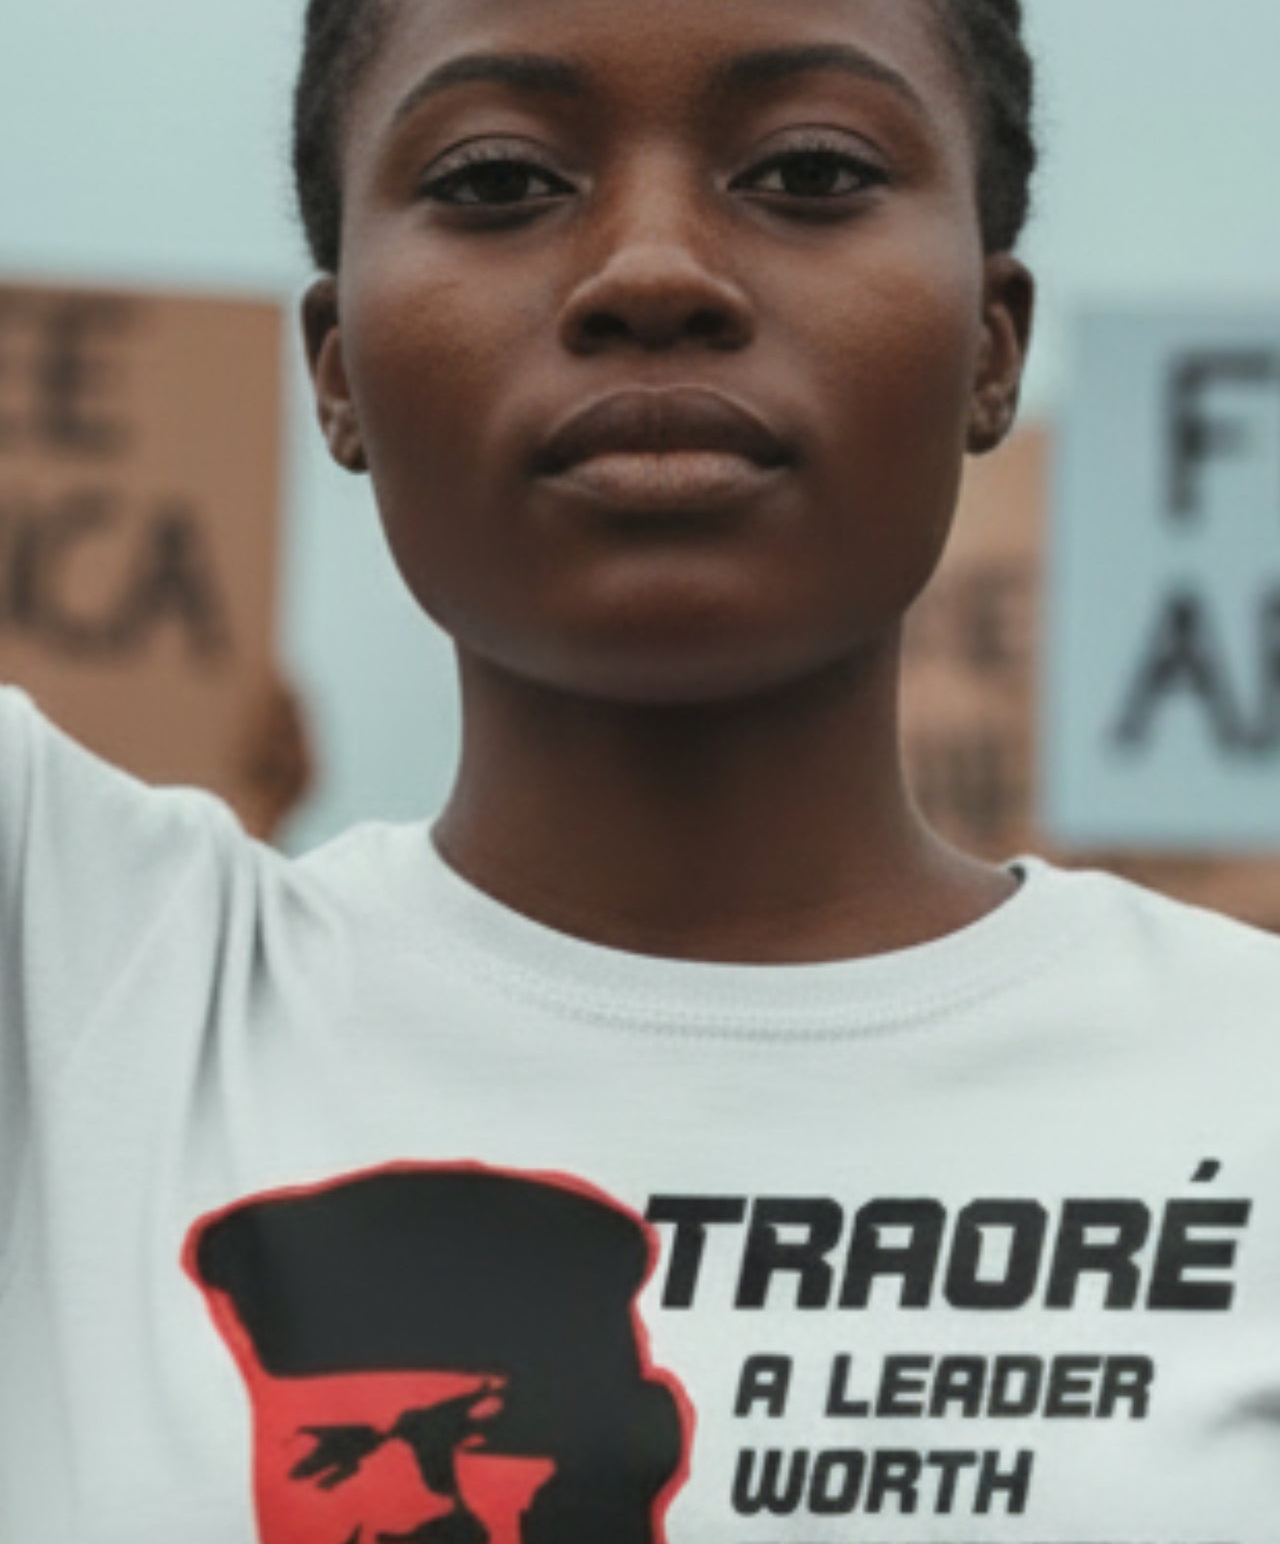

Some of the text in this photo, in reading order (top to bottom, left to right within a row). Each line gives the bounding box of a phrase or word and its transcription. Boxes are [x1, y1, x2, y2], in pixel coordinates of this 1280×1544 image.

[644, 1158, 1252, 1311] TRAORÉ
[733, 1354, 1155, 1418] A LEADER
[730, 1449, 1034, 1516] WORTH
